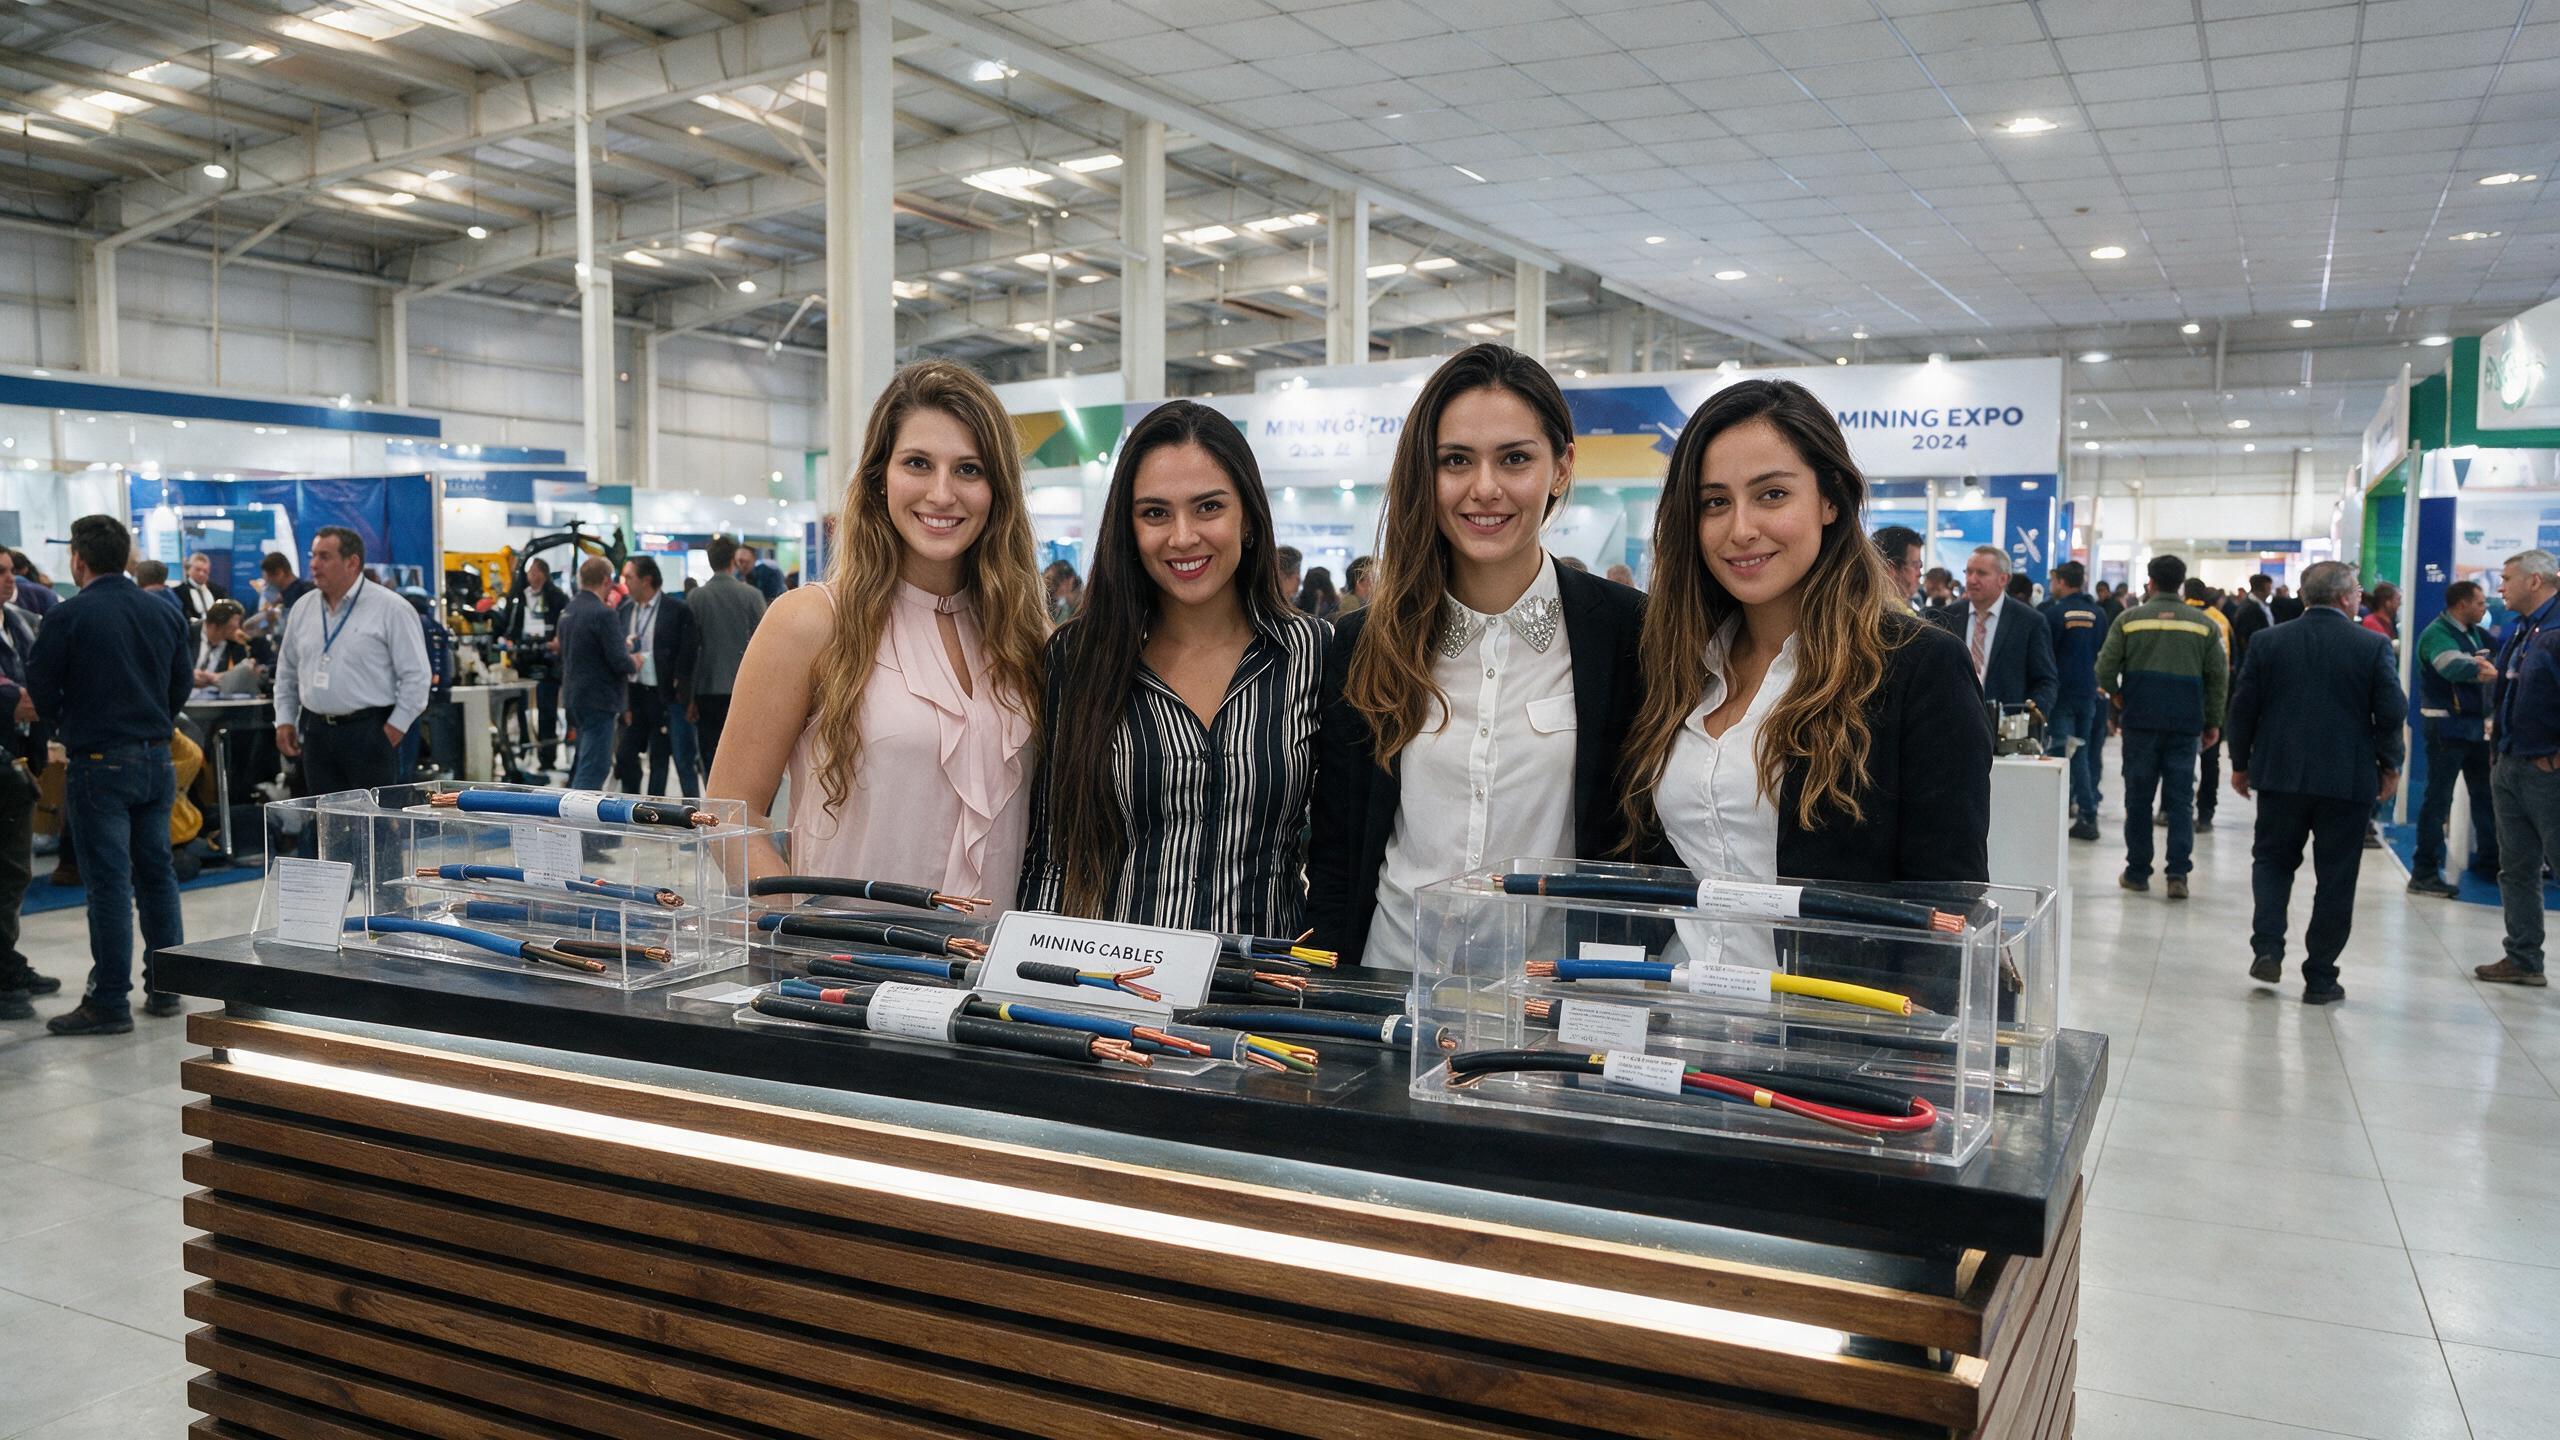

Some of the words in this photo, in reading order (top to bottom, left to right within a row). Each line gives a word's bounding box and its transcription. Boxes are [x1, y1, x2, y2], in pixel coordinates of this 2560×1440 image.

[1838, 409, 1939, 428] MINING
[1948, 407, 2024, 427] EXPO
[1912, 434, 1968, 450] 2024
[1029, 933, 1096, 954] MINING
[1099, 943, 1164, 964] CABLES
